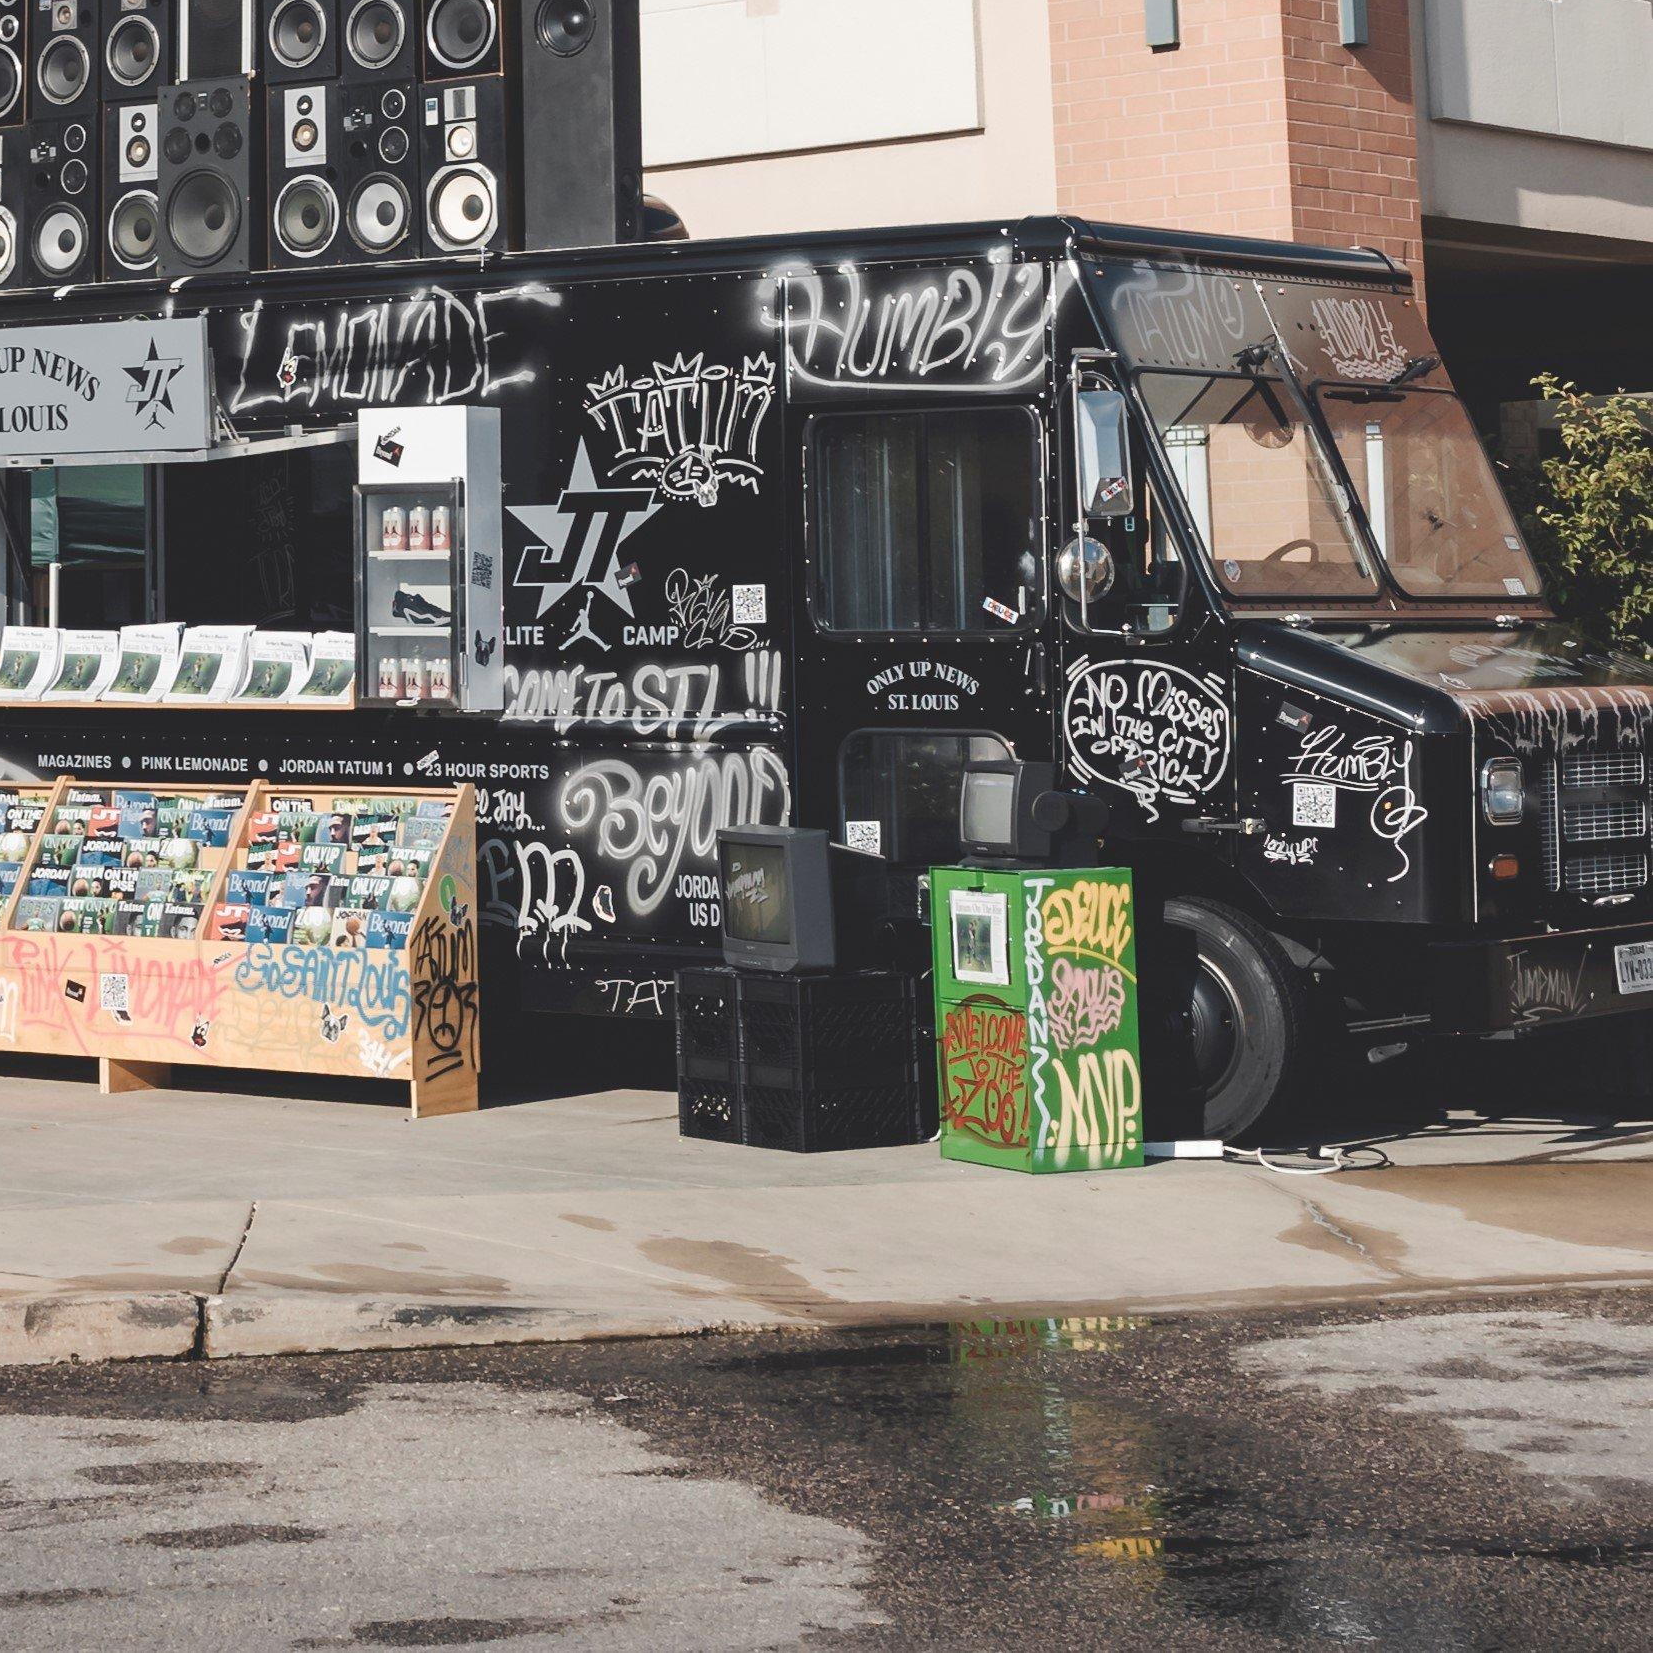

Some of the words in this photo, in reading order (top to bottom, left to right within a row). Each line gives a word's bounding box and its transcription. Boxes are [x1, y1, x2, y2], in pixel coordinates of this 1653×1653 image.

[30, 348, 101, 402] NEWS
[502, 626, 545, 646] LITE
[623, 626, 679, 646] CAMP
[866, 663, 905, 695] ONLY
[909, 661, 932, 678] UP
[934, 662, 980, 695] NEWS
[888, 694, 910, 710] ST.
[912, 694, 960, 711] LOUIS
[1074, 672, 1129, 714] NO
[1072, 715, 1107, 738] IN
[1158, 727, 1221, 775] CITY
[37, 754, 112, 769] MAGAZINES
[141, 756, 174, 771] PINK
[175, 756, 248, 772] LEMONADE
[279, 759, 342, 774] JORDAN
[344, 760, 384, 775] TATUM
[426, 763, 442, 777] 23
[445, 762, 487, 778] HOUR
[489, 763, 550, 780] SPORTS
[7, 809, 24, 820] ON
[272, 799, 290, 813] ON
[290, 801, 312, 813] THE
[122, 870, 138, 882] TH
[675, 874, 721, 900] JORDA
[216, 905, 250, 918] JT
